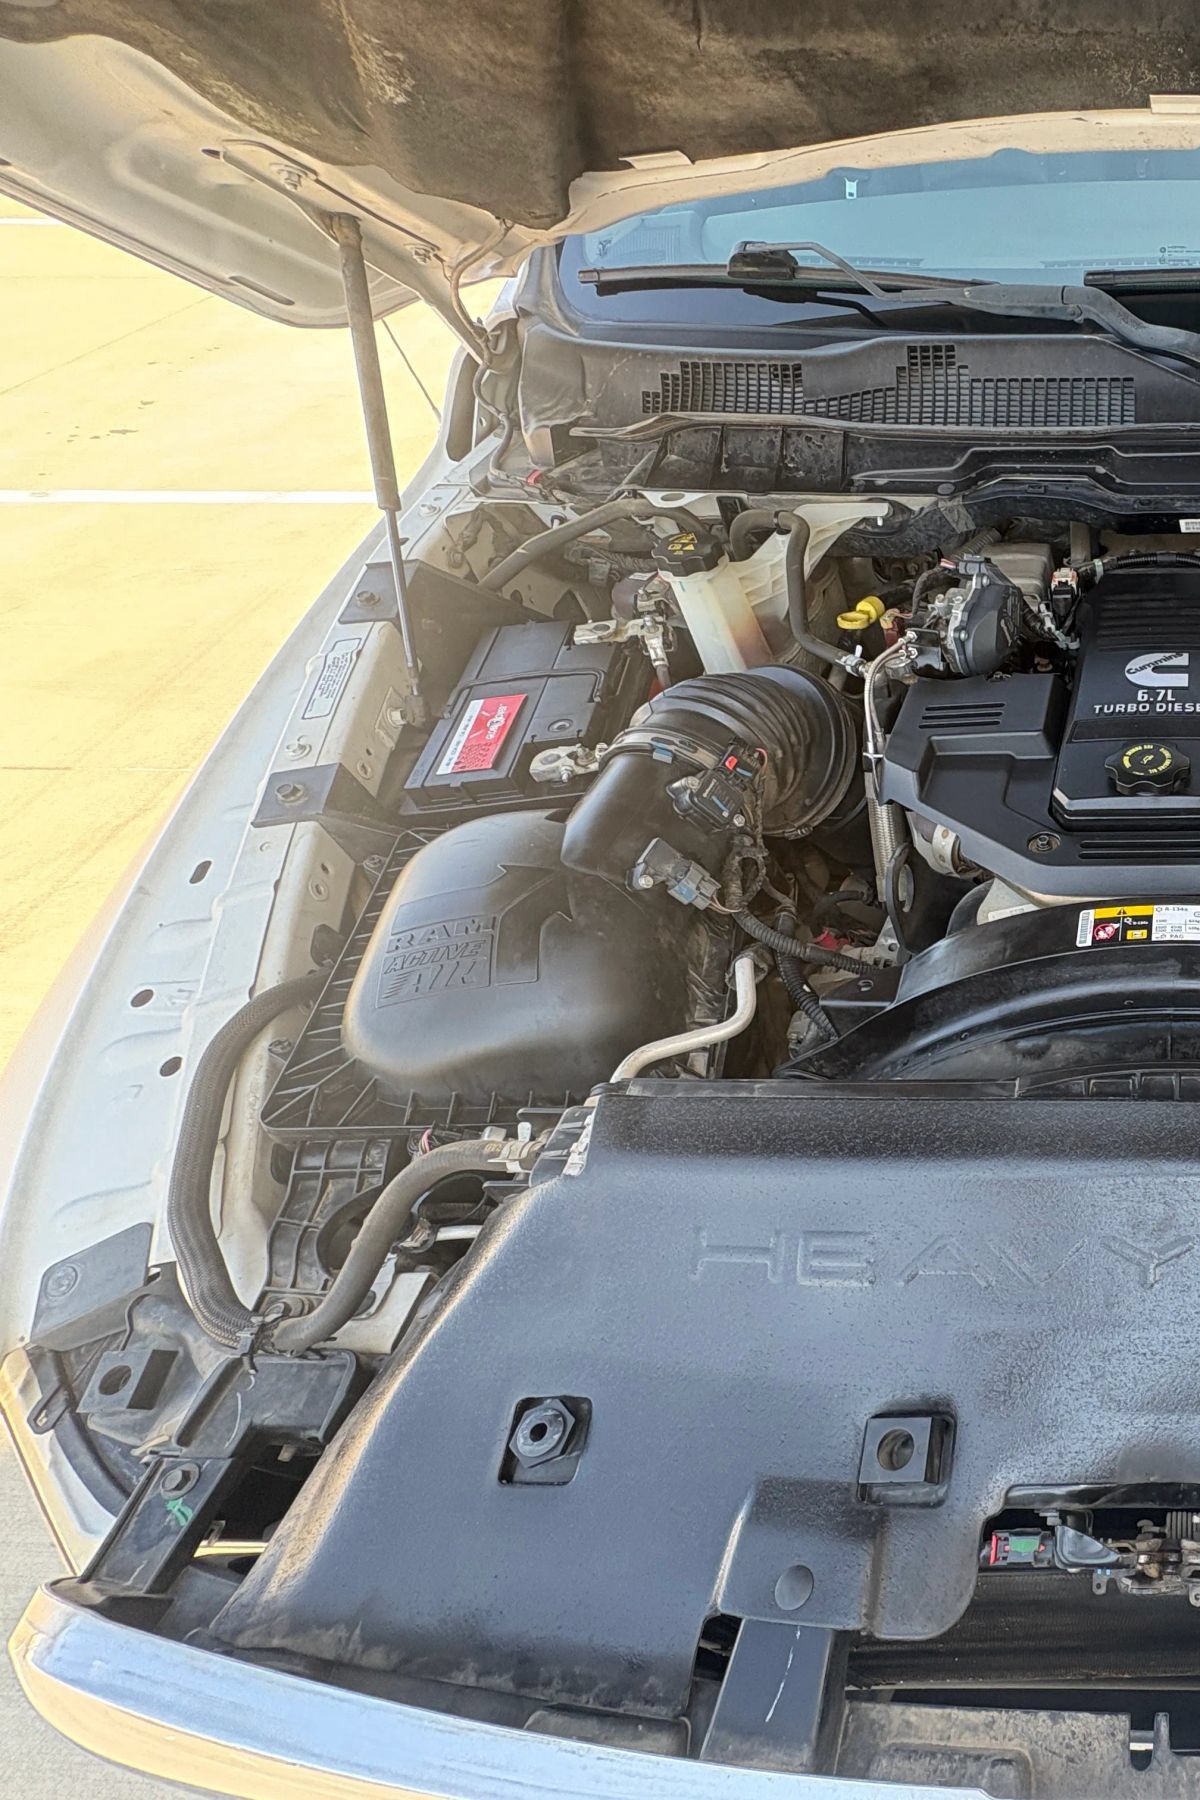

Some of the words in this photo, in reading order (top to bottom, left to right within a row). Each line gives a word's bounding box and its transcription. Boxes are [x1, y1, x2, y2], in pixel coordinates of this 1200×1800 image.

[1125, 653, 1186, 676] Cummins
[1093, 702, 1151, 714] TURBO
[1137, 689, 1176, 702] 6.7L
[385, 917, 495, 953] RAM
[383, 939, 487, 975] ACTIVE
[692, 1227, 1194, 1289] HEAVY
